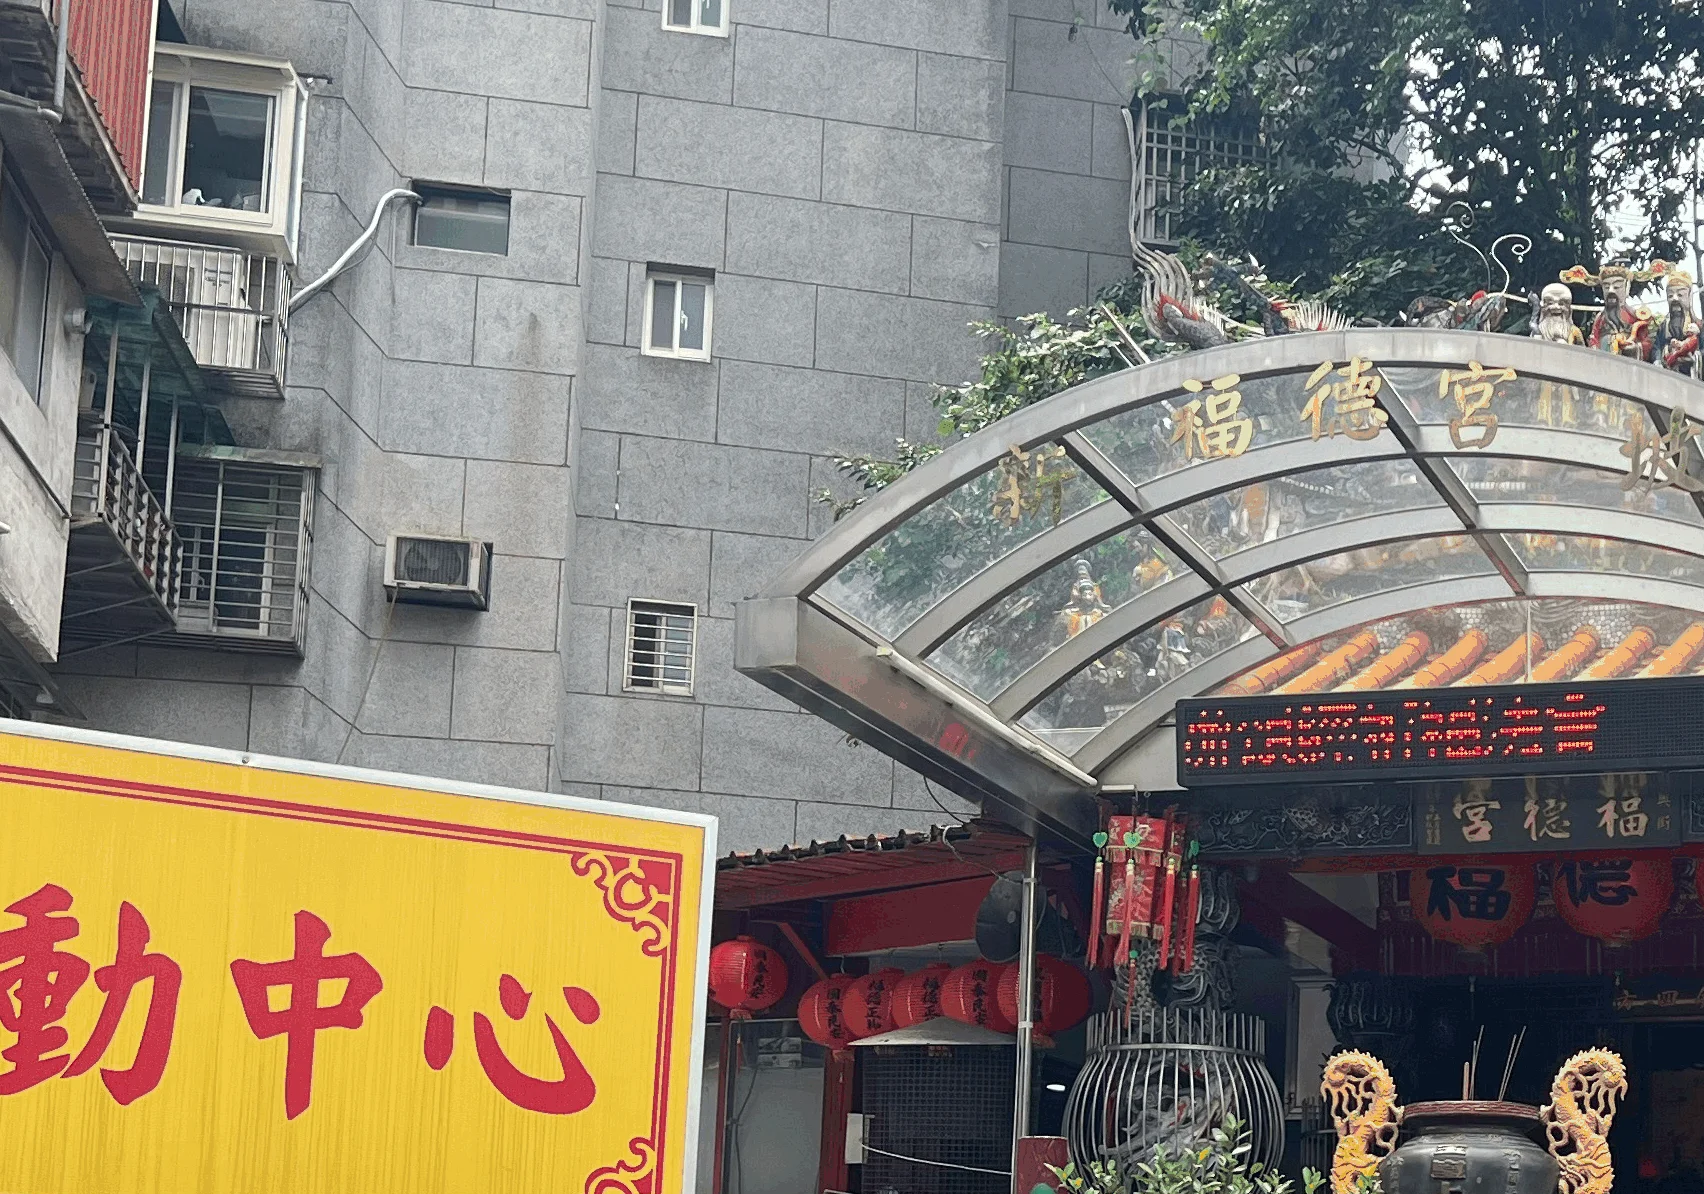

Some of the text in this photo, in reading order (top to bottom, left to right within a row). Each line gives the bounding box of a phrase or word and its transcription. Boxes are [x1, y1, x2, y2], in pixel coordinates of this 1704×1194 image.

[1170, 356, 1518, 459] 福德宮
[1452, 795, 1650, 844] 福德宮
[0, 883, 602, 1121] 動中心
